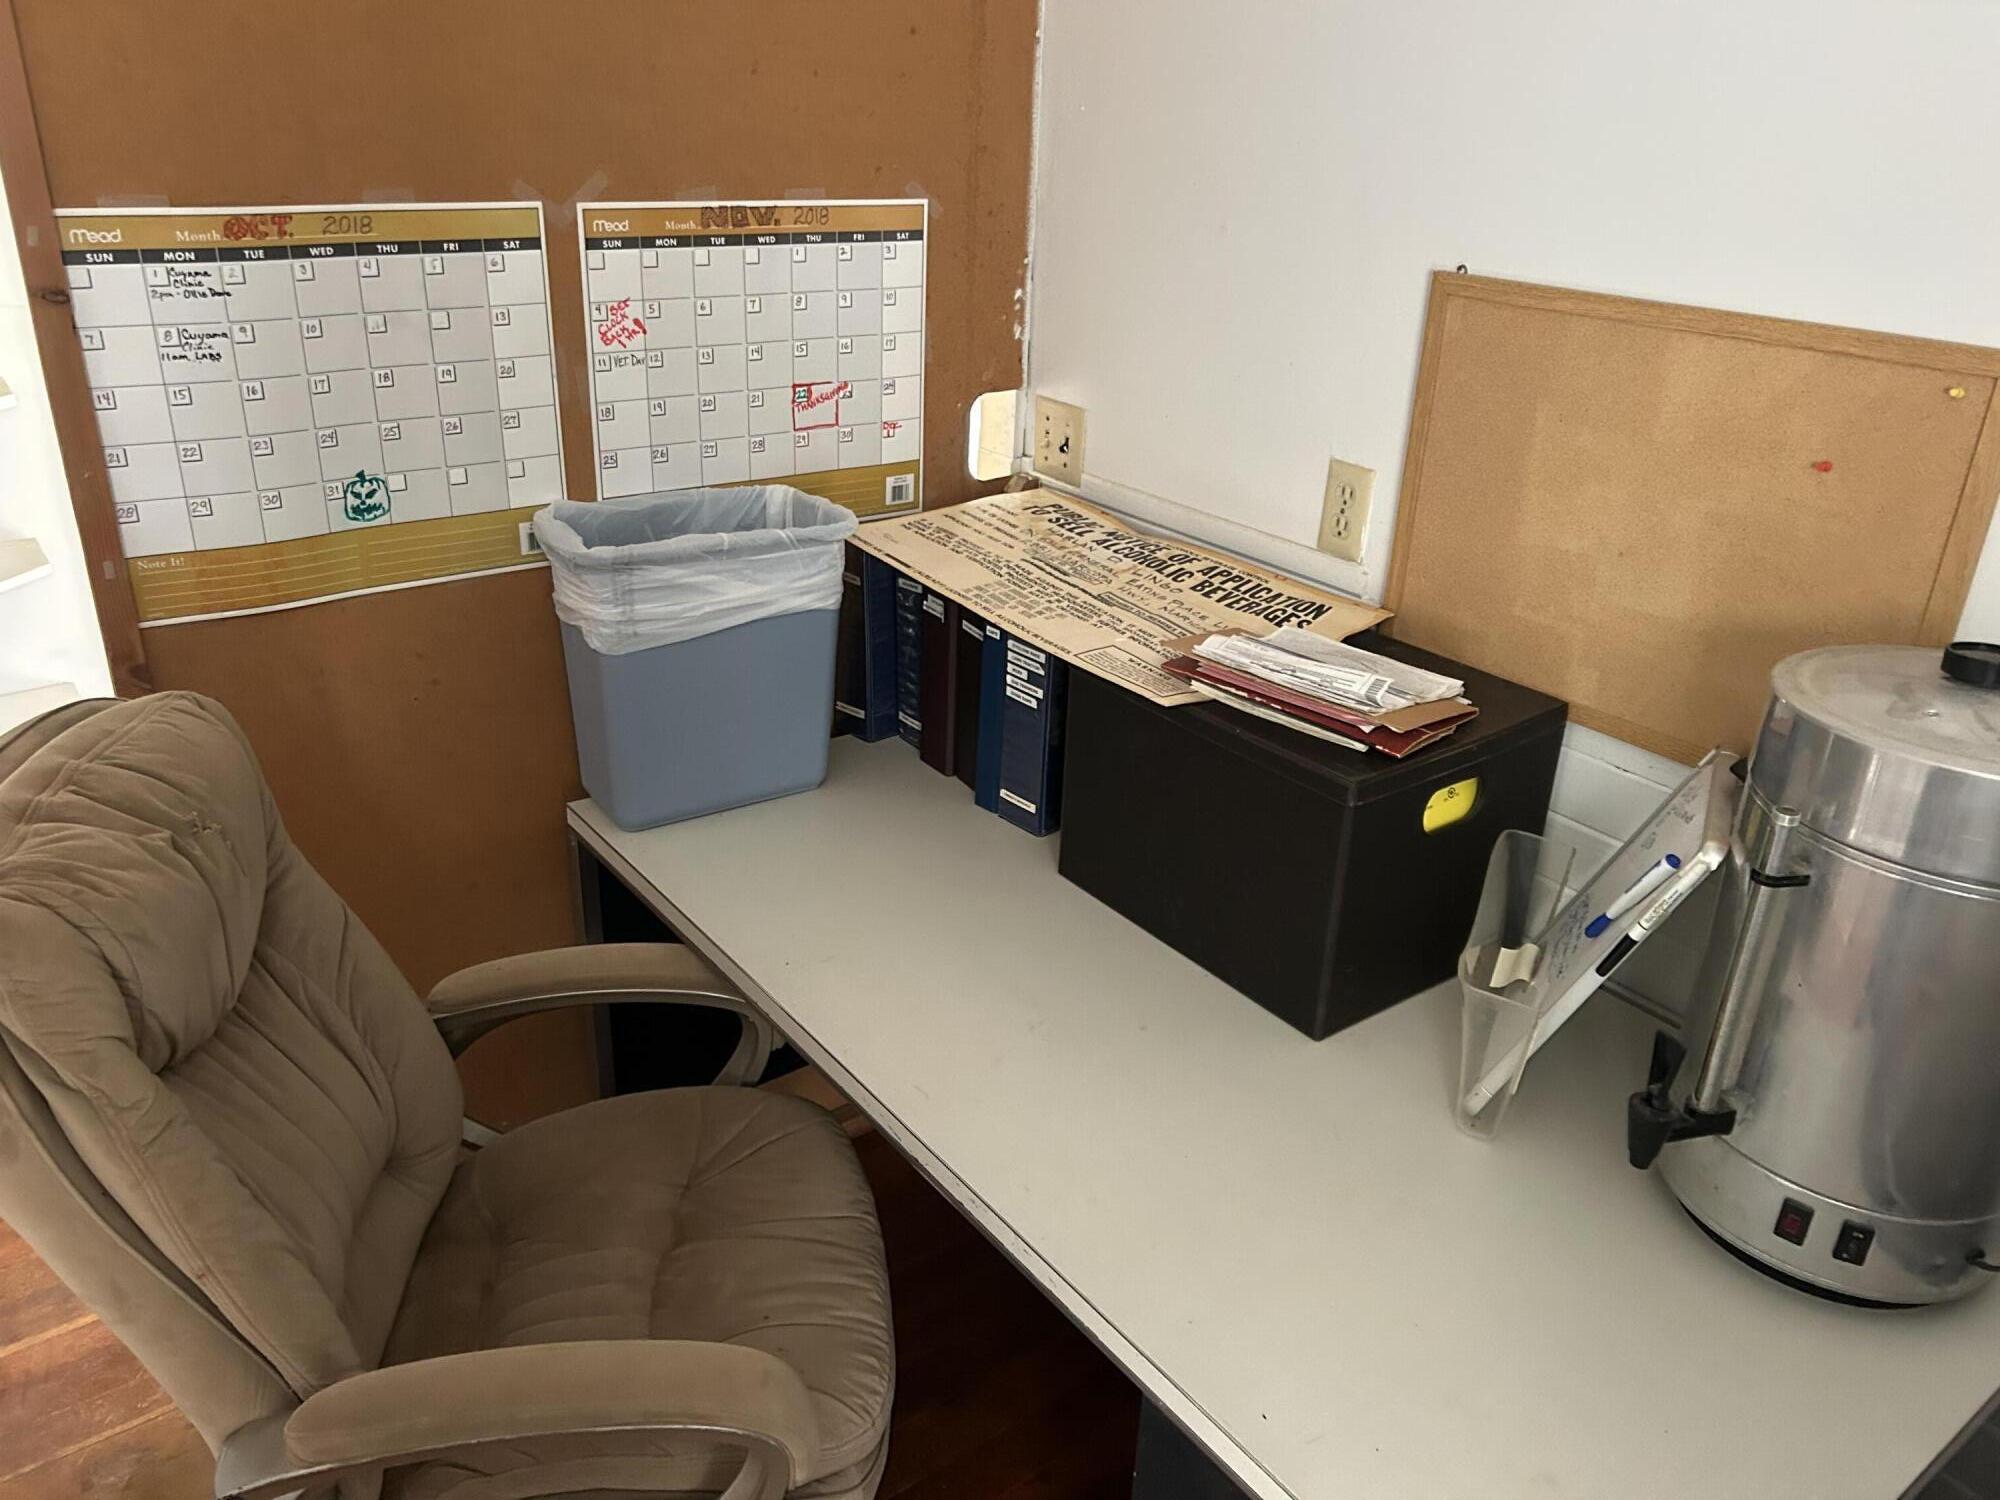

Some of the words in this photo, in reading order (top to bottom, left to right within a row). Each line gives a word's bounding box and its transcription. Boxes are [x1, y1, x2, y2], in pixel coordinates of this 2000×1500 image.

[793, 207, 830, 225] 2018
[322, 215, 373, 236] 2018
[665, 220, 697, 230] Month
[176, 230, 222, 242] Month
[710, 236, 726, 245] TUE
[757, 236, 776, 244] WED
[806, 234, 822, 242] THU
[853, 233, 865, 241] FRI
[896, 232, 909, 240] SAT
[443, 241, 460, 252] FRI
[502, 239, 521, 250] SAT
[602, 239, 622, 248] SUN
[655, 238, 677, 247] MON
[309, 246, 334, 257] WED
[376, 243, 399, 254] THU
[840, 247, 848, 256] 2
[885, 246, 892, 254] 3
[85, 252, 114, 263] SUN
[163, 250, 196, 261] MON
[243, 249, 266, 260] TUE
[489, 257, 499, 268] 6
[299, 264, 307, 275] 3
[795, 296, 803, 307] 8
[841, 294, 848, 304] 9
[648, 304, 655, 314] 5
[699, 303, 706, 312] 6
[750, 300, 757, 310] 7
[495, 312, 506, 322] 13
[239, 326, 248, 339] 9
[305, 324, 317, 334] 10
[164, 330, 172, 342] 8
[796, 343, 805, 353] 15
[840, 342, 850, 351] 16
[885, 338, 893, 347] 17
[702, 351, 711, 360] 13
[750, 347, 760, 357] 14
[649, 355, 661, 364] 12
[441, 368, 453, 379] 19
[499, 366, 513, 375] 20
[378, 373, 390, 384] 18
[245, 384, 259, 396] 16
[314, 379, 326, 391] 17
[883, 383, 894, 391] 24
[172, 387, 187, 400] 15
[751, 393, 761, 403] 21
[795, 389, 807, 399] 22
[97, 394, 111, 406] 14
[702, 399, 713, 407] 20
[653, 401, 663, 412] 19
[600, 407, 612, 418] 18
[503, 415, 518, 426] 27
[383, 426, 398, 438] 25
[445, 421, 460, 432] 26
[320, 433, 335, 444] 24
[796, 434, 806, 445] 29
[840, 431, 852, 440] 30
[253, 440, 270, 450] 23
[703, 445, 715, 454] 27
[752, 439, 764, 449] 28
[181, 447, 199, 458] 22
[652, 449, 666, 459] 26
[108, 453, 121, 464] 21
[603, 455, 617, 466] 25
[327, 486, 341, 497] 31
[262, 494, 279, 506] 30
[118, 507, 135, 518] 28
[191, 501, 208, 513] 29
[137, 560, 167, 570] Note
[170, 557, 185, 567] It!
[1022, 505, 1052, 516] TO
[1047, 516, 1095, 537] SELL
[1091, 538, 1194, 583] ALCOHOLIC
[1189, 579, 1312, 630] BEVERAGES
[1040, 503, 1104, 529] PUBLIC
[1101, 530, 1171, 555] NOTICE
[1167, 553, 1200, 567] OF
[1197, 565, 1333, 621] APPLICATION
